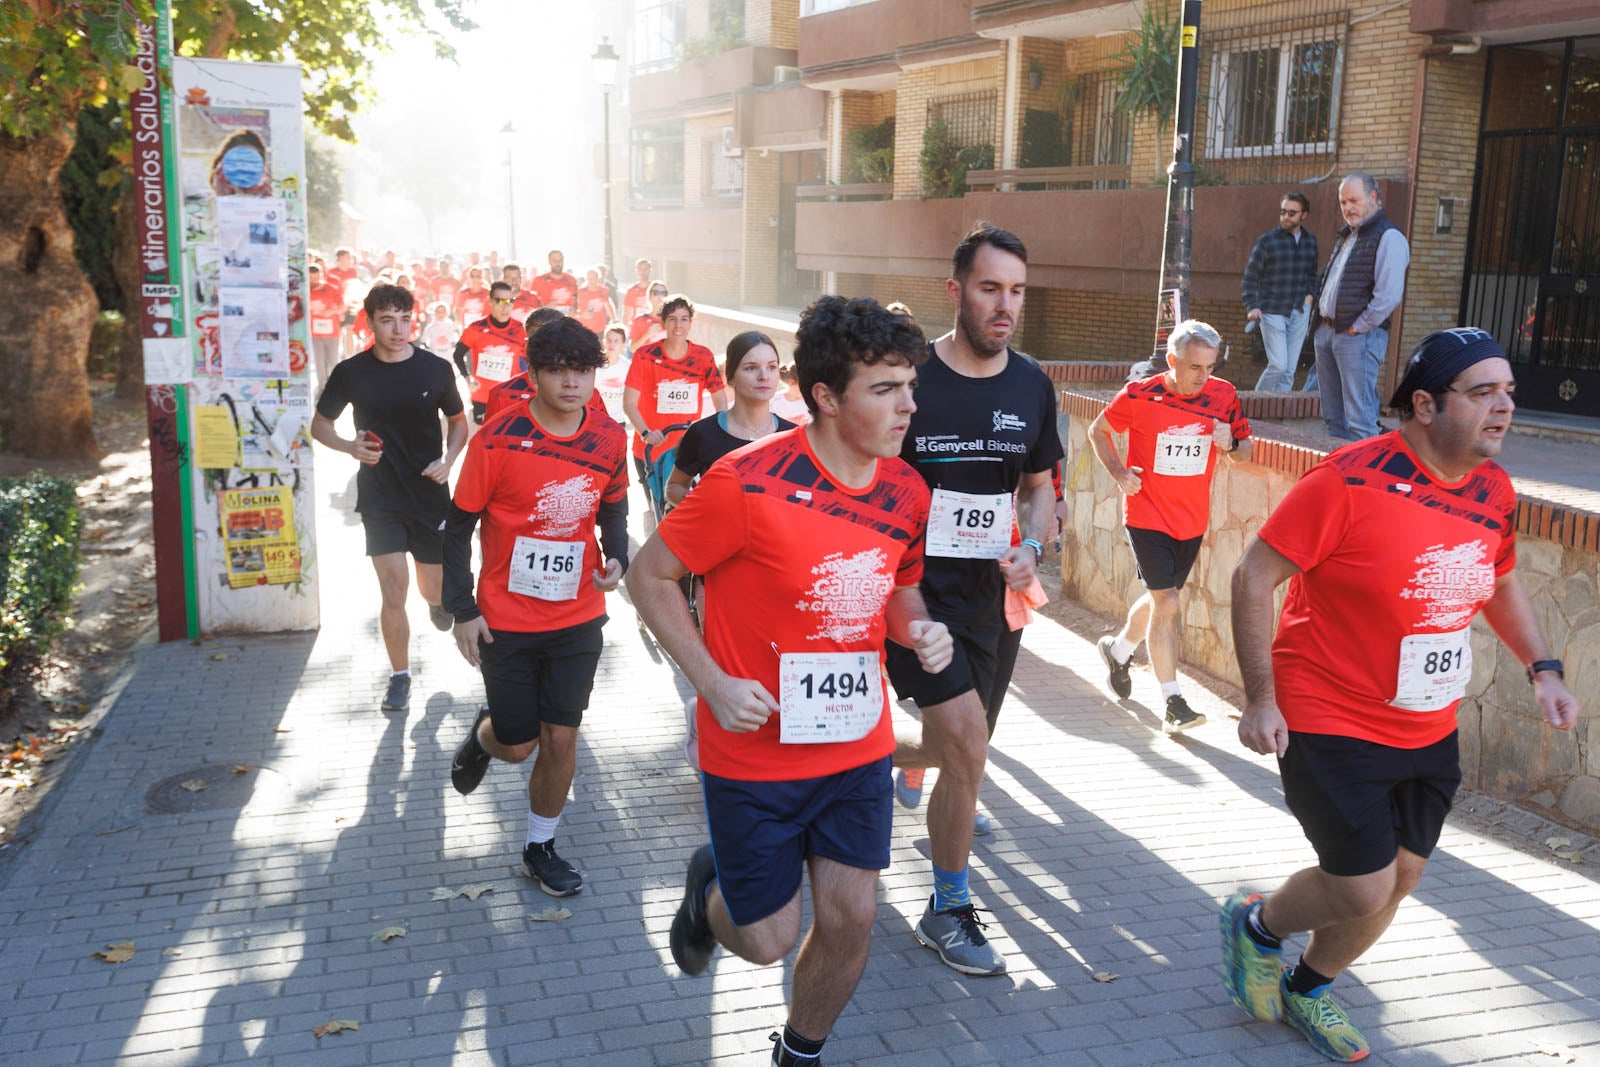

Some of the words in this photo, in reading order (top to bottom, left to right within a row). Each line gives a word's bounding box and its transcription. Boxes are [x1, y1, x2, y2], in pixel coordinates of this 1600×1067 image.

[144, 286, 178, 295] MPS
[668, 391, 689, 400] 460
[927, 439, 984, 453] Genycell
[987, 439, 1026, 454] Biotech
[1165, 444, 1201, 457] 1713
[537, 493, 595, 510] carrera
[953, 508, 995, 529] 189
[265, 551, 285, 562] 149
[525, 552, 574, 573] 1156
[1416, 567, 1495, 585] carrera
[813, 578, 890, 596] carrera
[1424, 647, 1463, 675] 881
[800, 671, 869, 699] 1494
